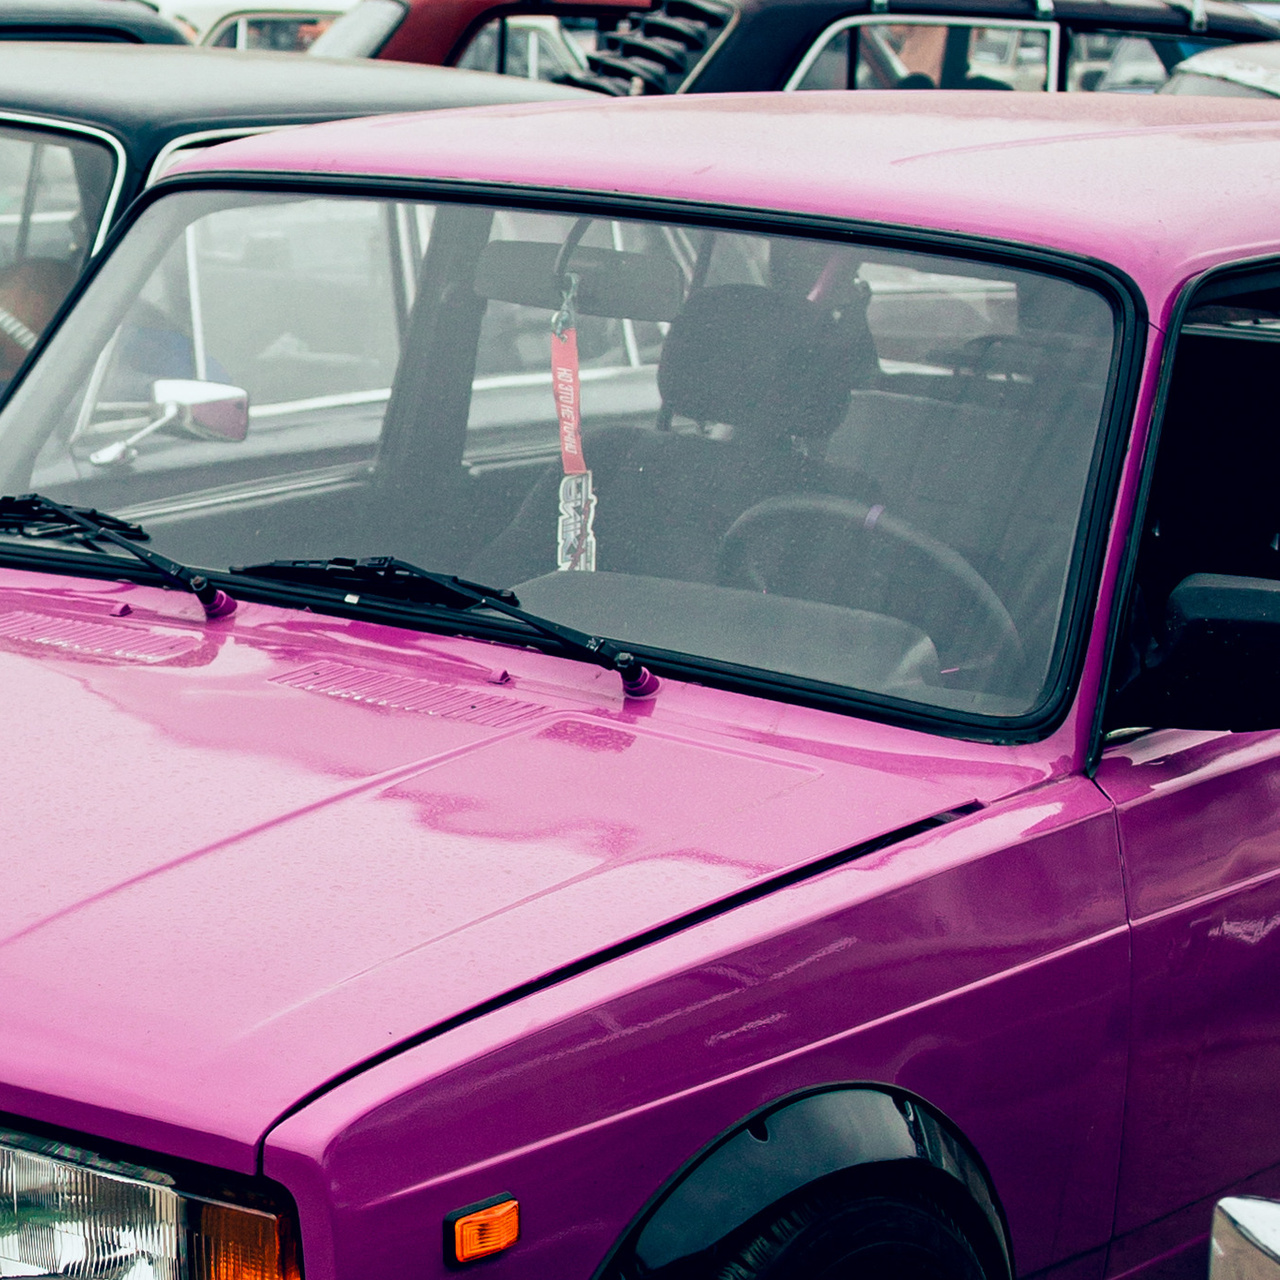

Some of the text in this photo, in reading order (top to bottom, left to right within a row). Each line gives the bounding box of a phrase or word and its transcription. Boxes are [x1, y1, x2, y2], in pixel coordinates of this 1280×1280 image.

[557, 367, 573, 382] НО
[558, 383, 574, 404] ЭТО
[560, 404, 575, 421] НЕ
